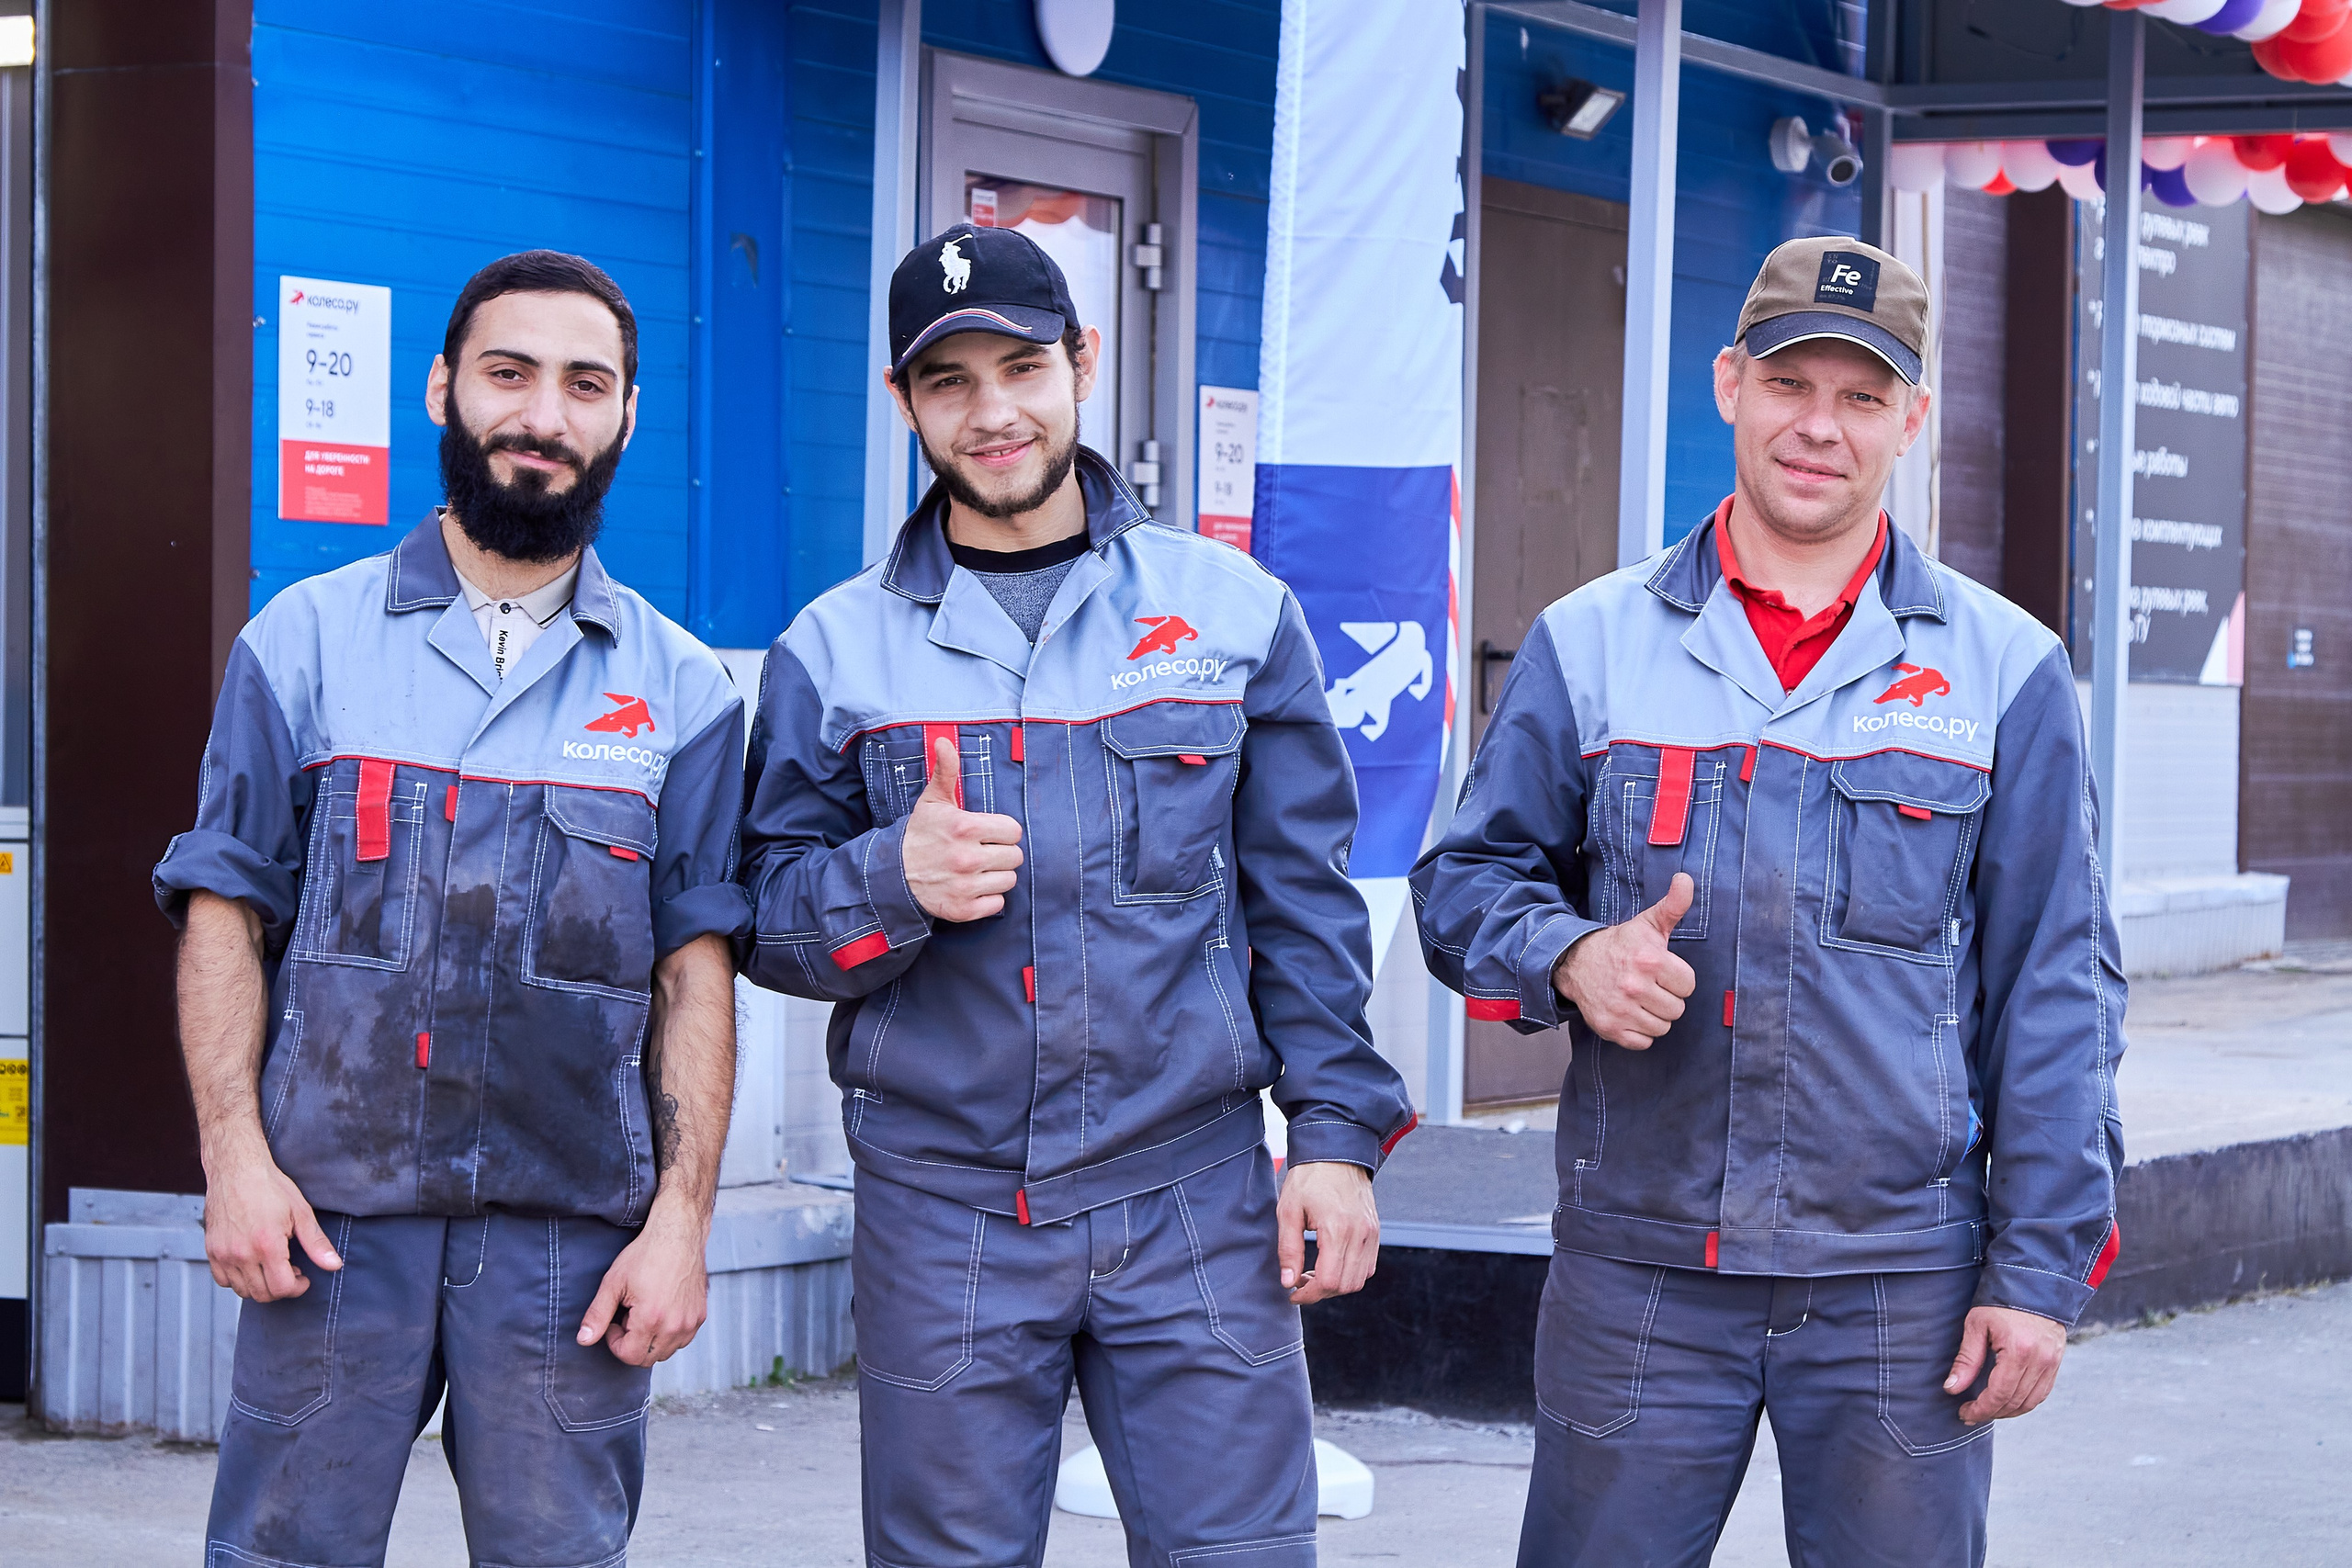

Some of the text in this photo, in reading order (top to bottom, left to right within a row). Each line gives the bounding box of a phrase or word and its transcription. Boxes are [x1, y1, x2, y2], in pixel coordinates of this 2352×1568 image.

[1830, 264, 1862, 287] Fe
[1820, 284, 1854, 295] Effective
[496, 629, 508, 655] Kevin
[1111, 659, 1228, 690] колесо.ру
[1853, 711, 1979, 742] колесо.ру
